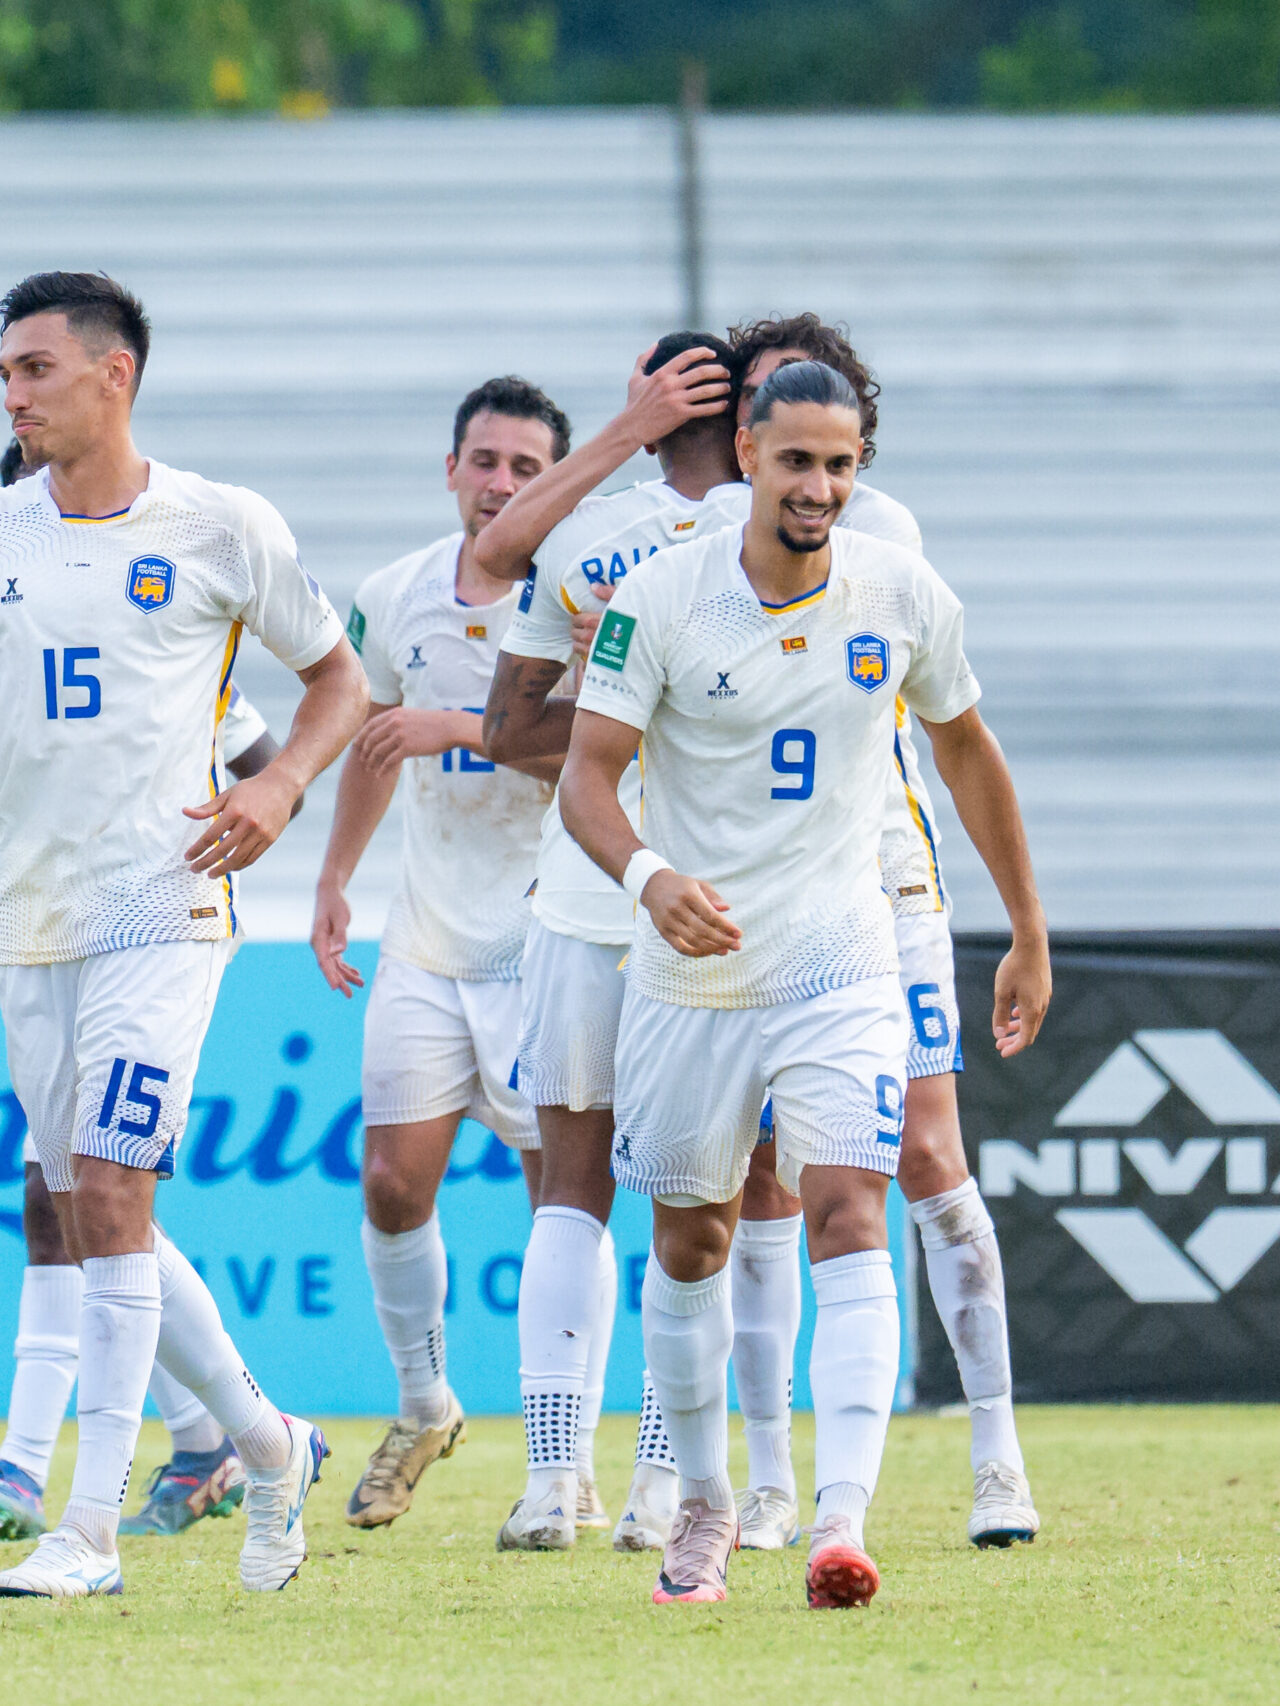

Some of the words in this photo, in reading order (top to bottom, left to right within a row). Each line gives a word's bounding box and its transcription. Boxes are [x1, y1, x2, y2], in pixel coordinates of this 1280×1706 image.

[43, 647, 101, 719] 15
[707, 689, 739, 697] NEXXUS
[771, 729, 816, 800] 9
[907, 983, 950, 1048] 6
[97, 1058, 169, 1138] 15
[875, 1074, 904, 1147] 9
[979, 1137, 1280, 1196] NIVI
